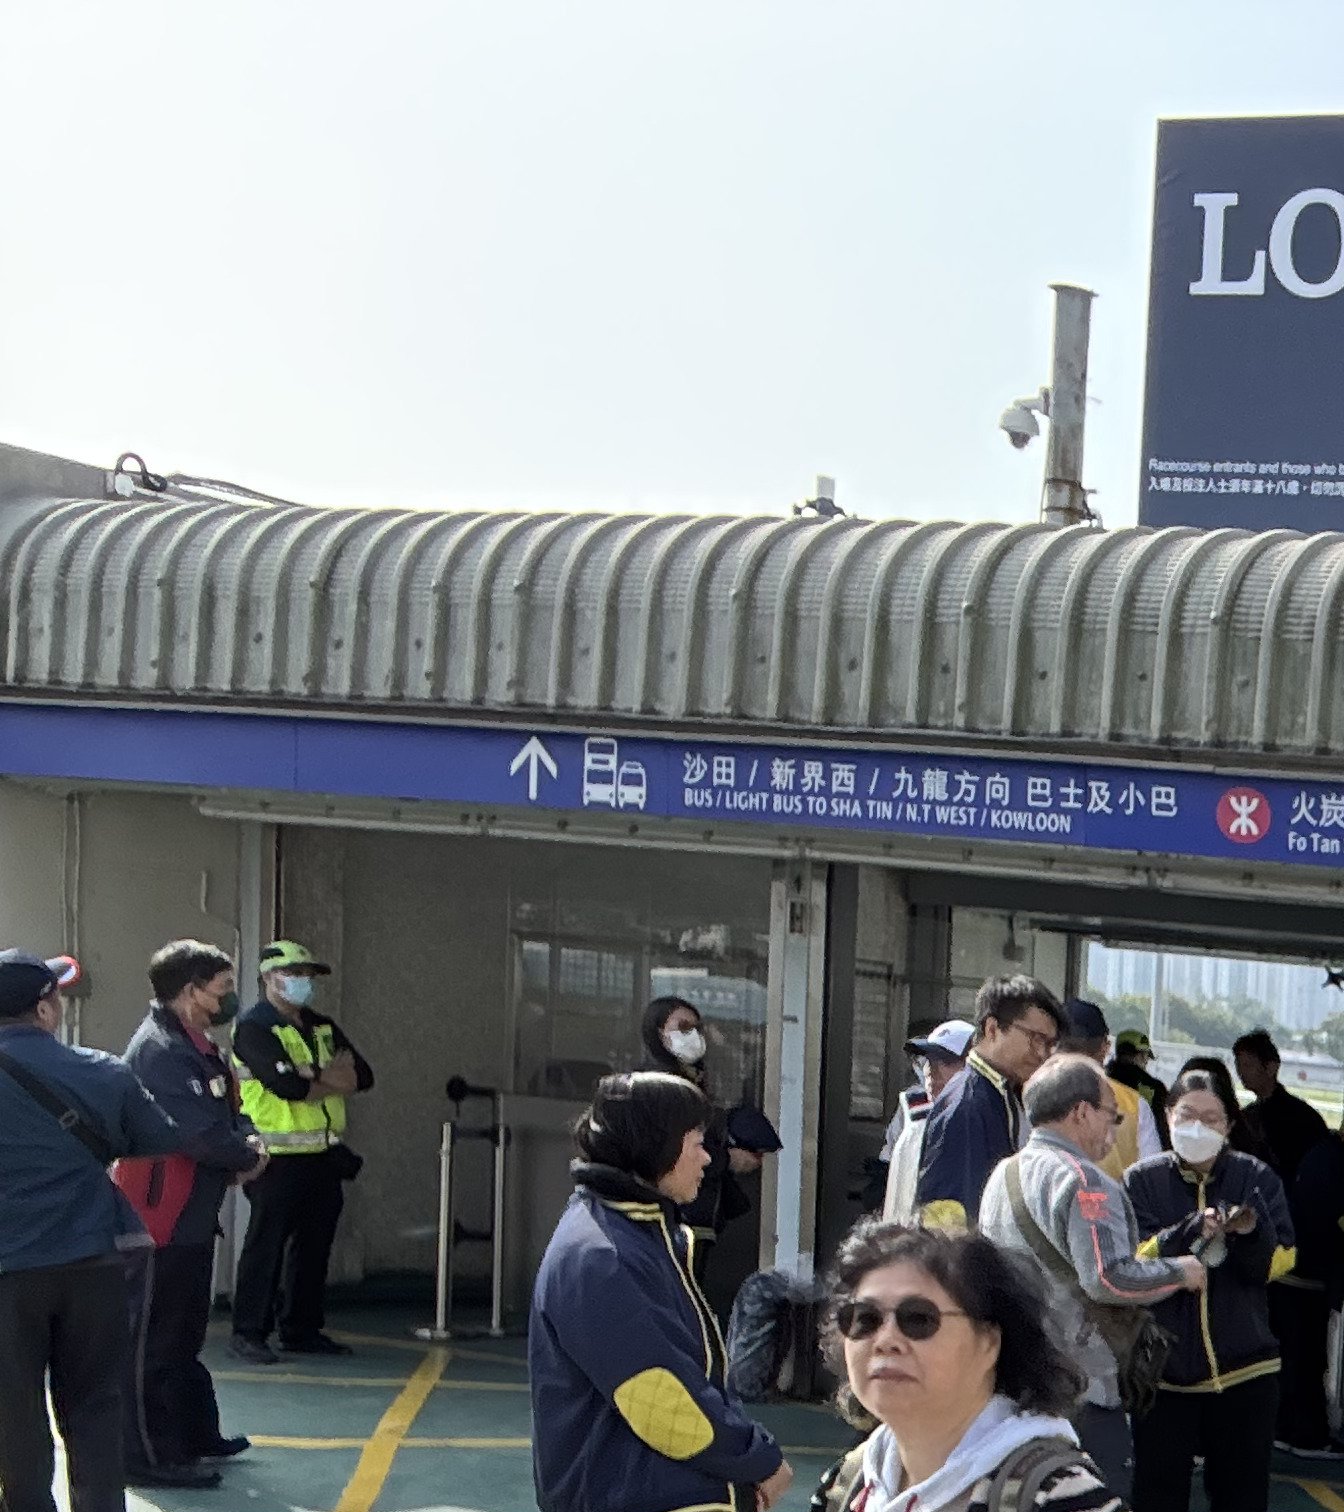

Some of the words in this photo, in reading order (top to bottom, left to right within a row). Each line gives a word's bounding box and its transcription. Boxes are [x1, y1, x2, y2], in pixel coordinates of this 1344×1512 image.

[682, 752, 736, 788] 沙田
[770, 758, 856, 795] 新界西
[893, 766, 1011, 806] 九龍方向
[1027, 777, 1178, 817] 巴士及小巴
[684, 787, 713, 808] BUS
[725, 789, 769, 812] LIGHT
[773, 793, 802, 815] BUS
[806, 795, 827, 816] TO
[831, 797, 861, 819] SHA
[866, 799, 892, 821] TIN
[906, 802, 931, 824] N.T
[935, 804, 978, 827] WEST
[991, 808, 1072, 834] KOWLOON
[1288, 831, 1309, 853] Fo
[1310, 832, 1341, 854] Tan
